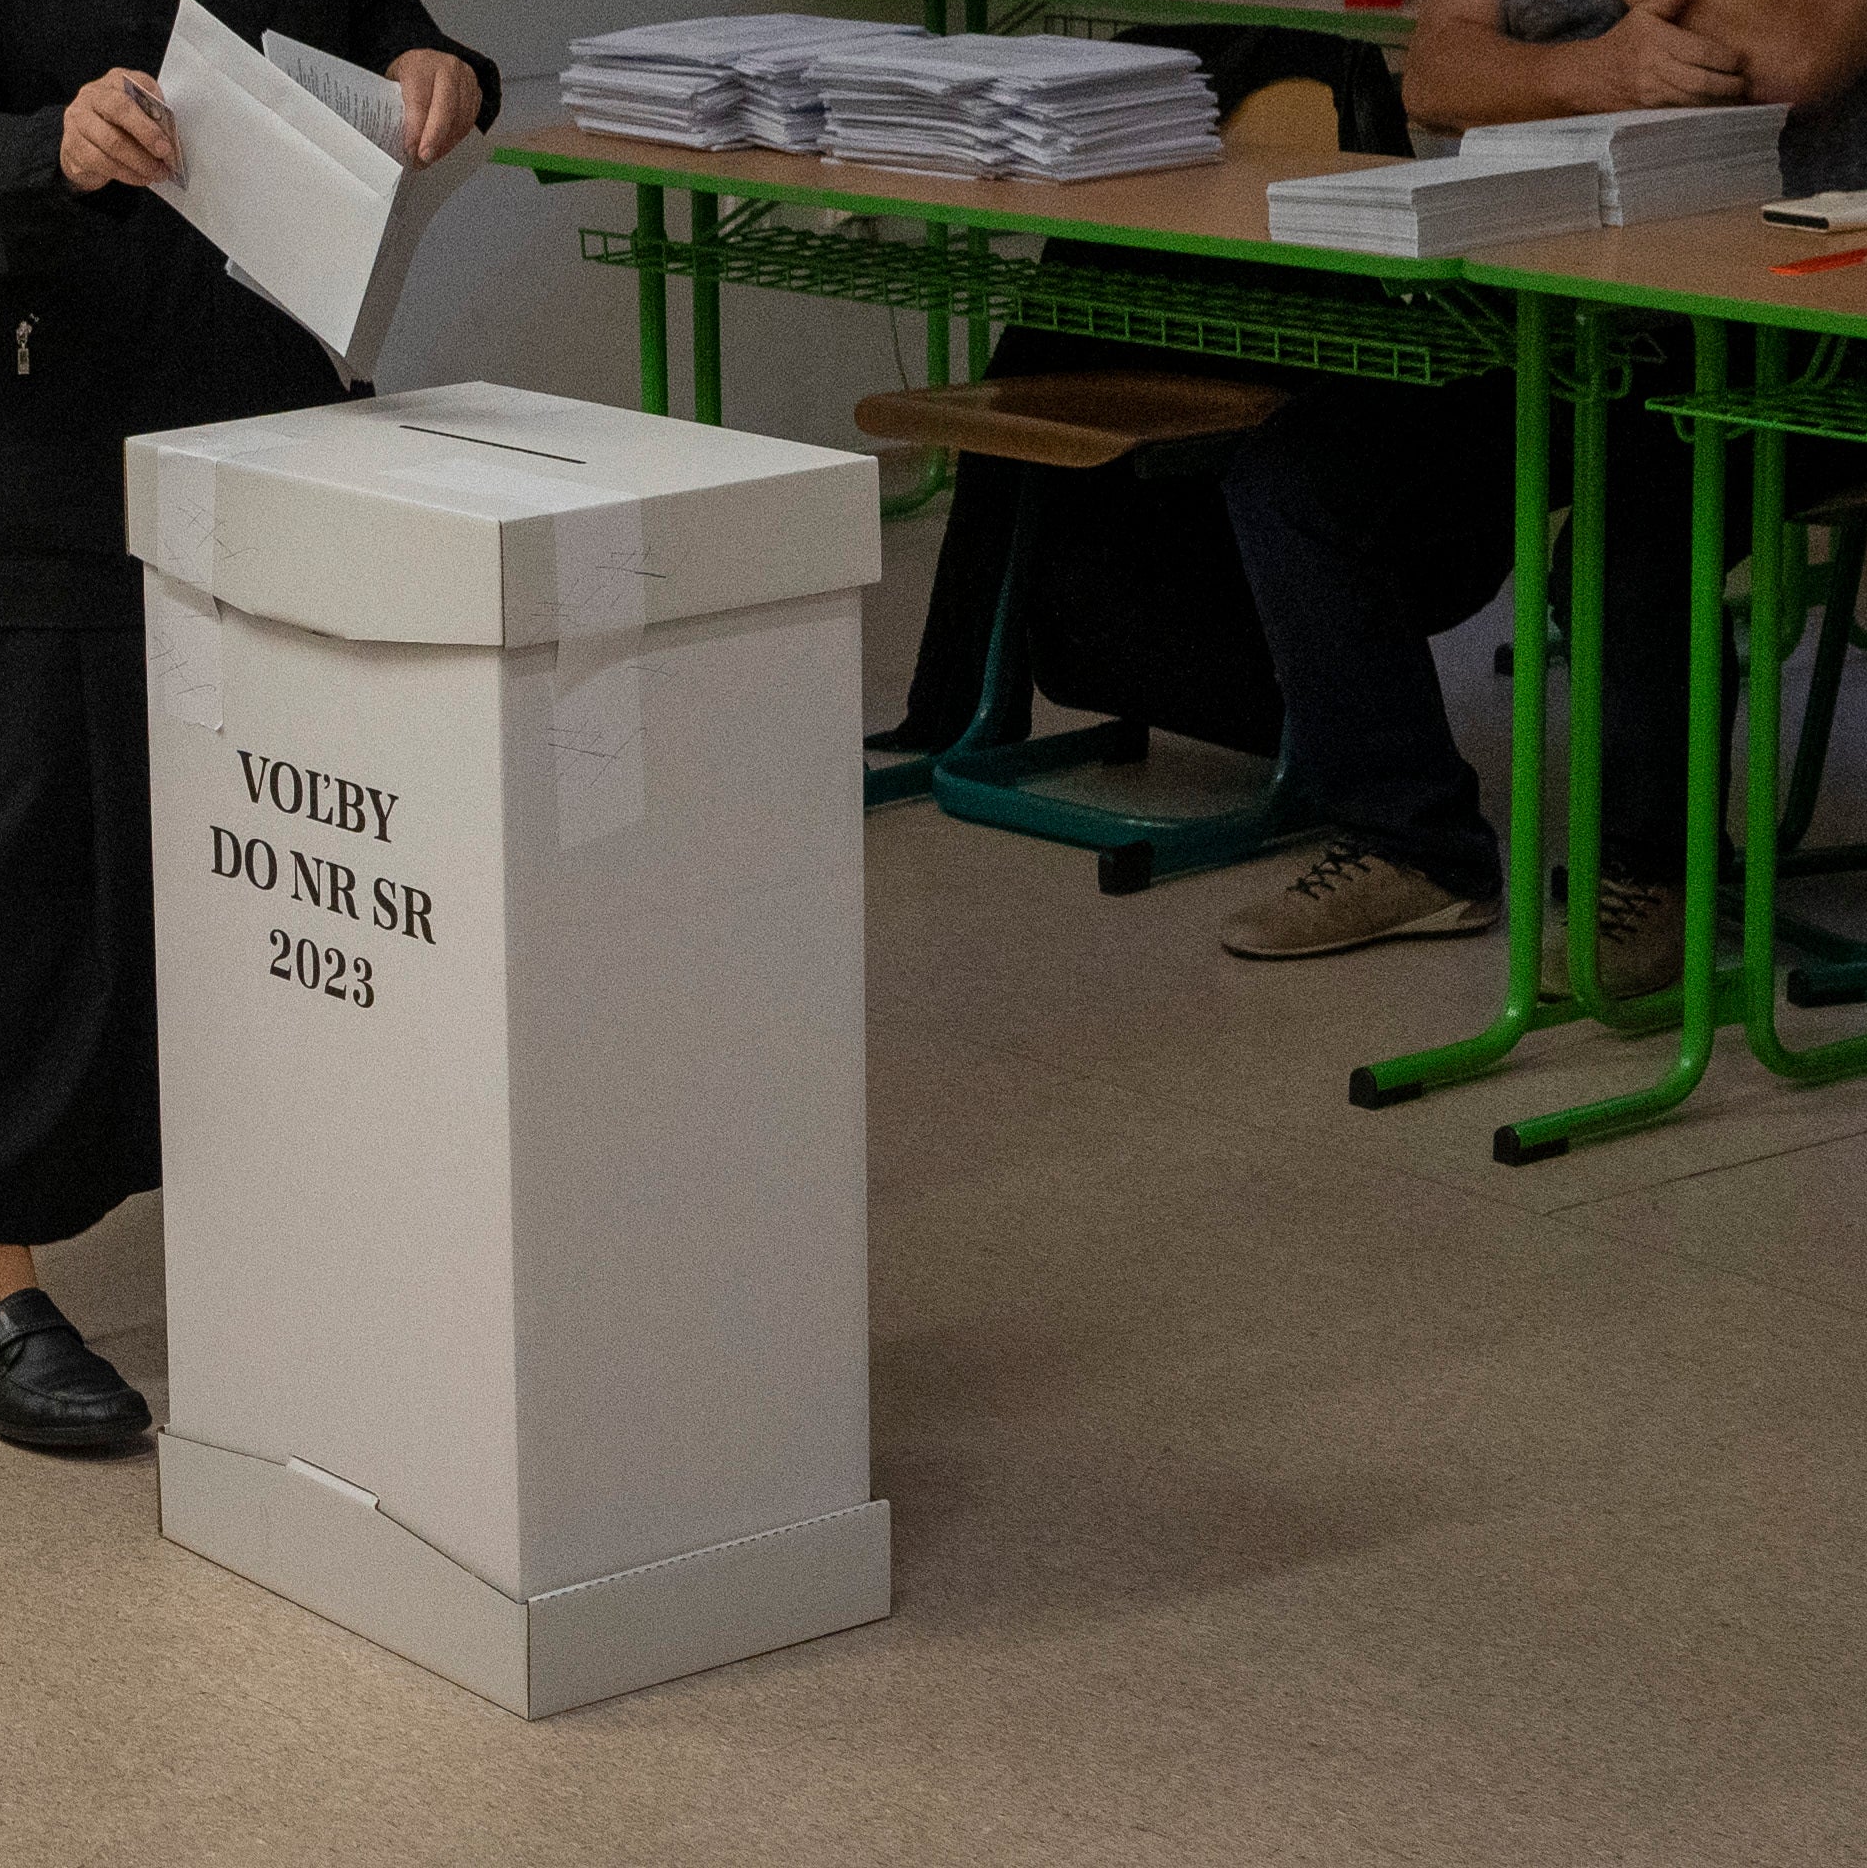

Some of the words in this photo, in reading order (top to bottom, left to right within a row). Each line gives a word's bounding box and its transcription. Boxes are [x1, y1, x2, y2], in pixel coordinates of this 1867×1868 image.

[236, 749, 399, 843] VOĽBY
[210, 825, 278, 891] DO
[290, 850, 359, 920] NR
[372, 877, 436, 945] SR
[269, 929, 375, 1009] 2023
